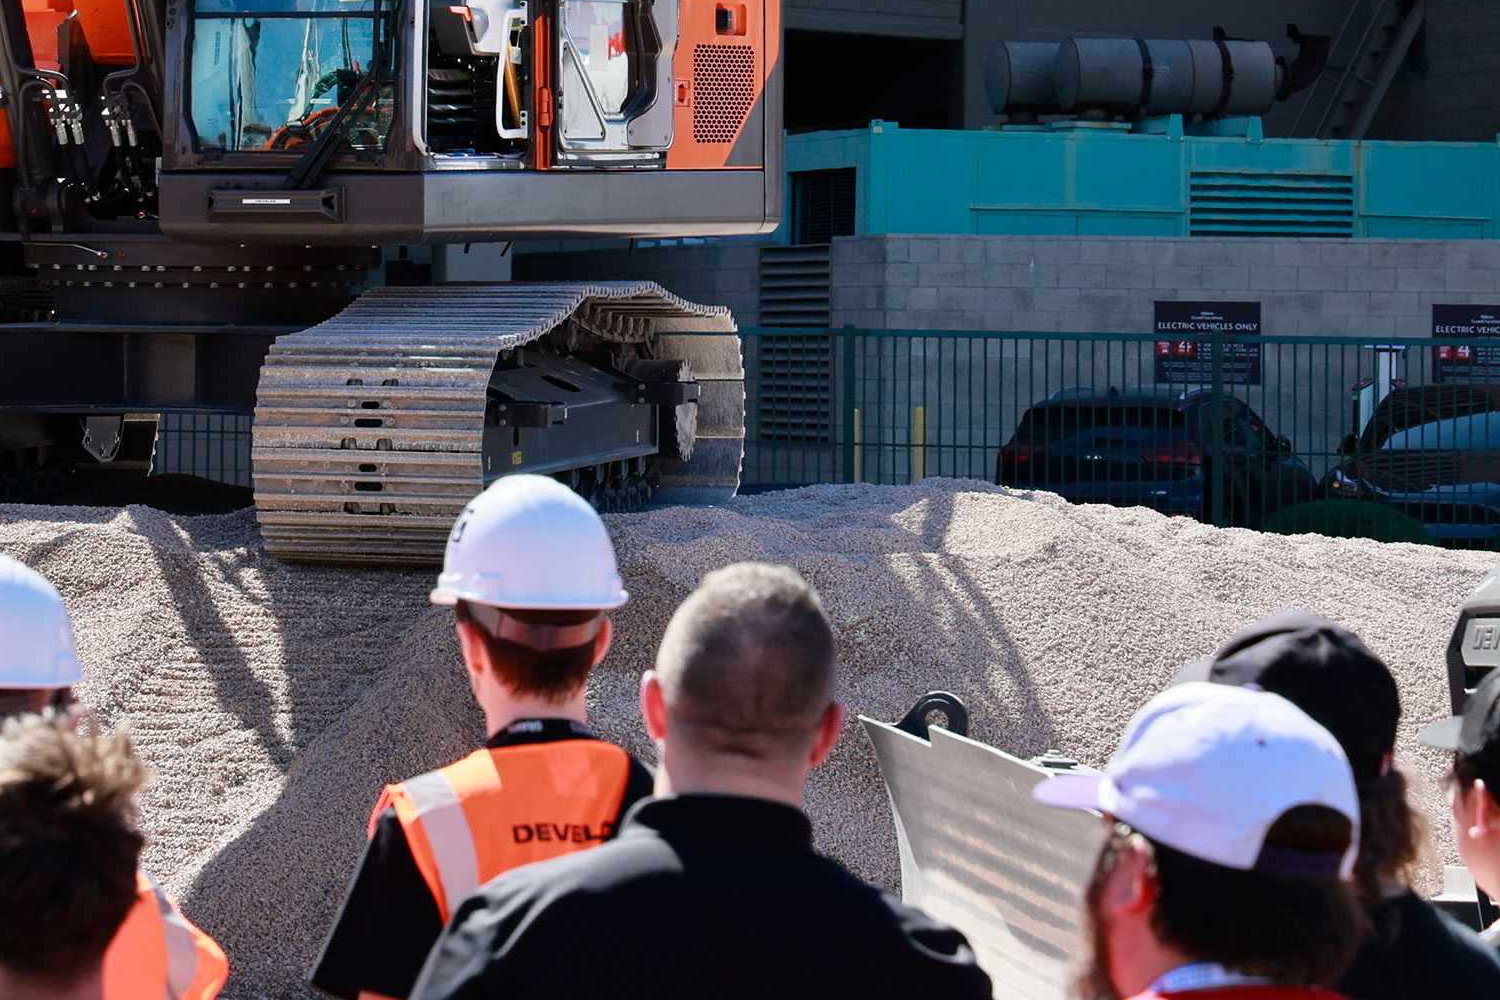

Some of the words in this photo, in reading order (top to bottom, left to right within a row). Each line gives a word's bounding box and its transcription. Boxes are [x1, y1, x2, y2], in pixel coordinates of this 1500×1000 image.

[1158, 322, 1195, 330] ELECTRIC
[1196, 322, 1233, 330] VEHICLES
[1235, 323, 1258, 331] ONLY
[1435, 325, 1475, 333] ELECTRIC
[1457, 345, 1470, 357] 4
